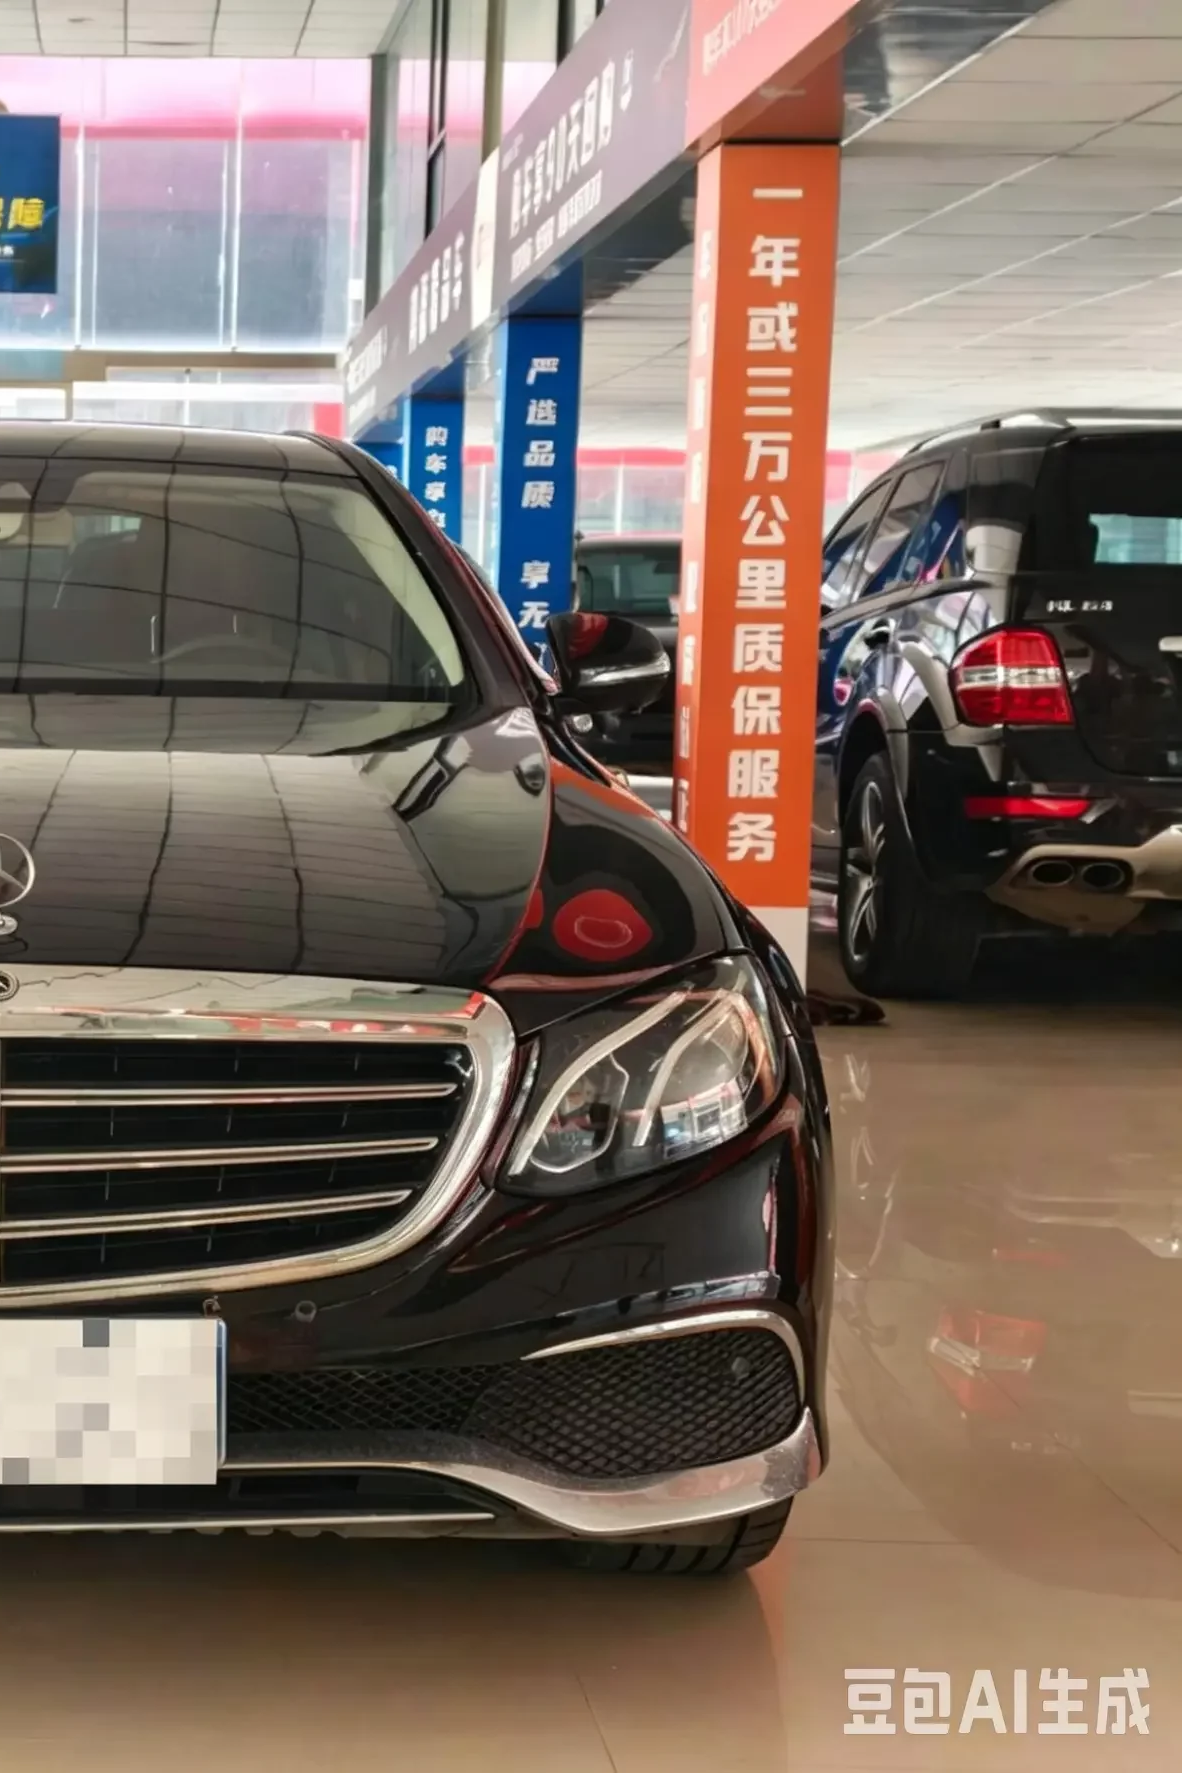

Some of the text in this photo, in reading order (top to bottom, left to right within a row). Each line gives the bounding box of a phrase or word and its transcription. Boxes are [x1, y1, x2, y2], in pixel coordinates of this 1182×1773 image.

[727, 188, 803, 862] 一年或三万公里质保服务
